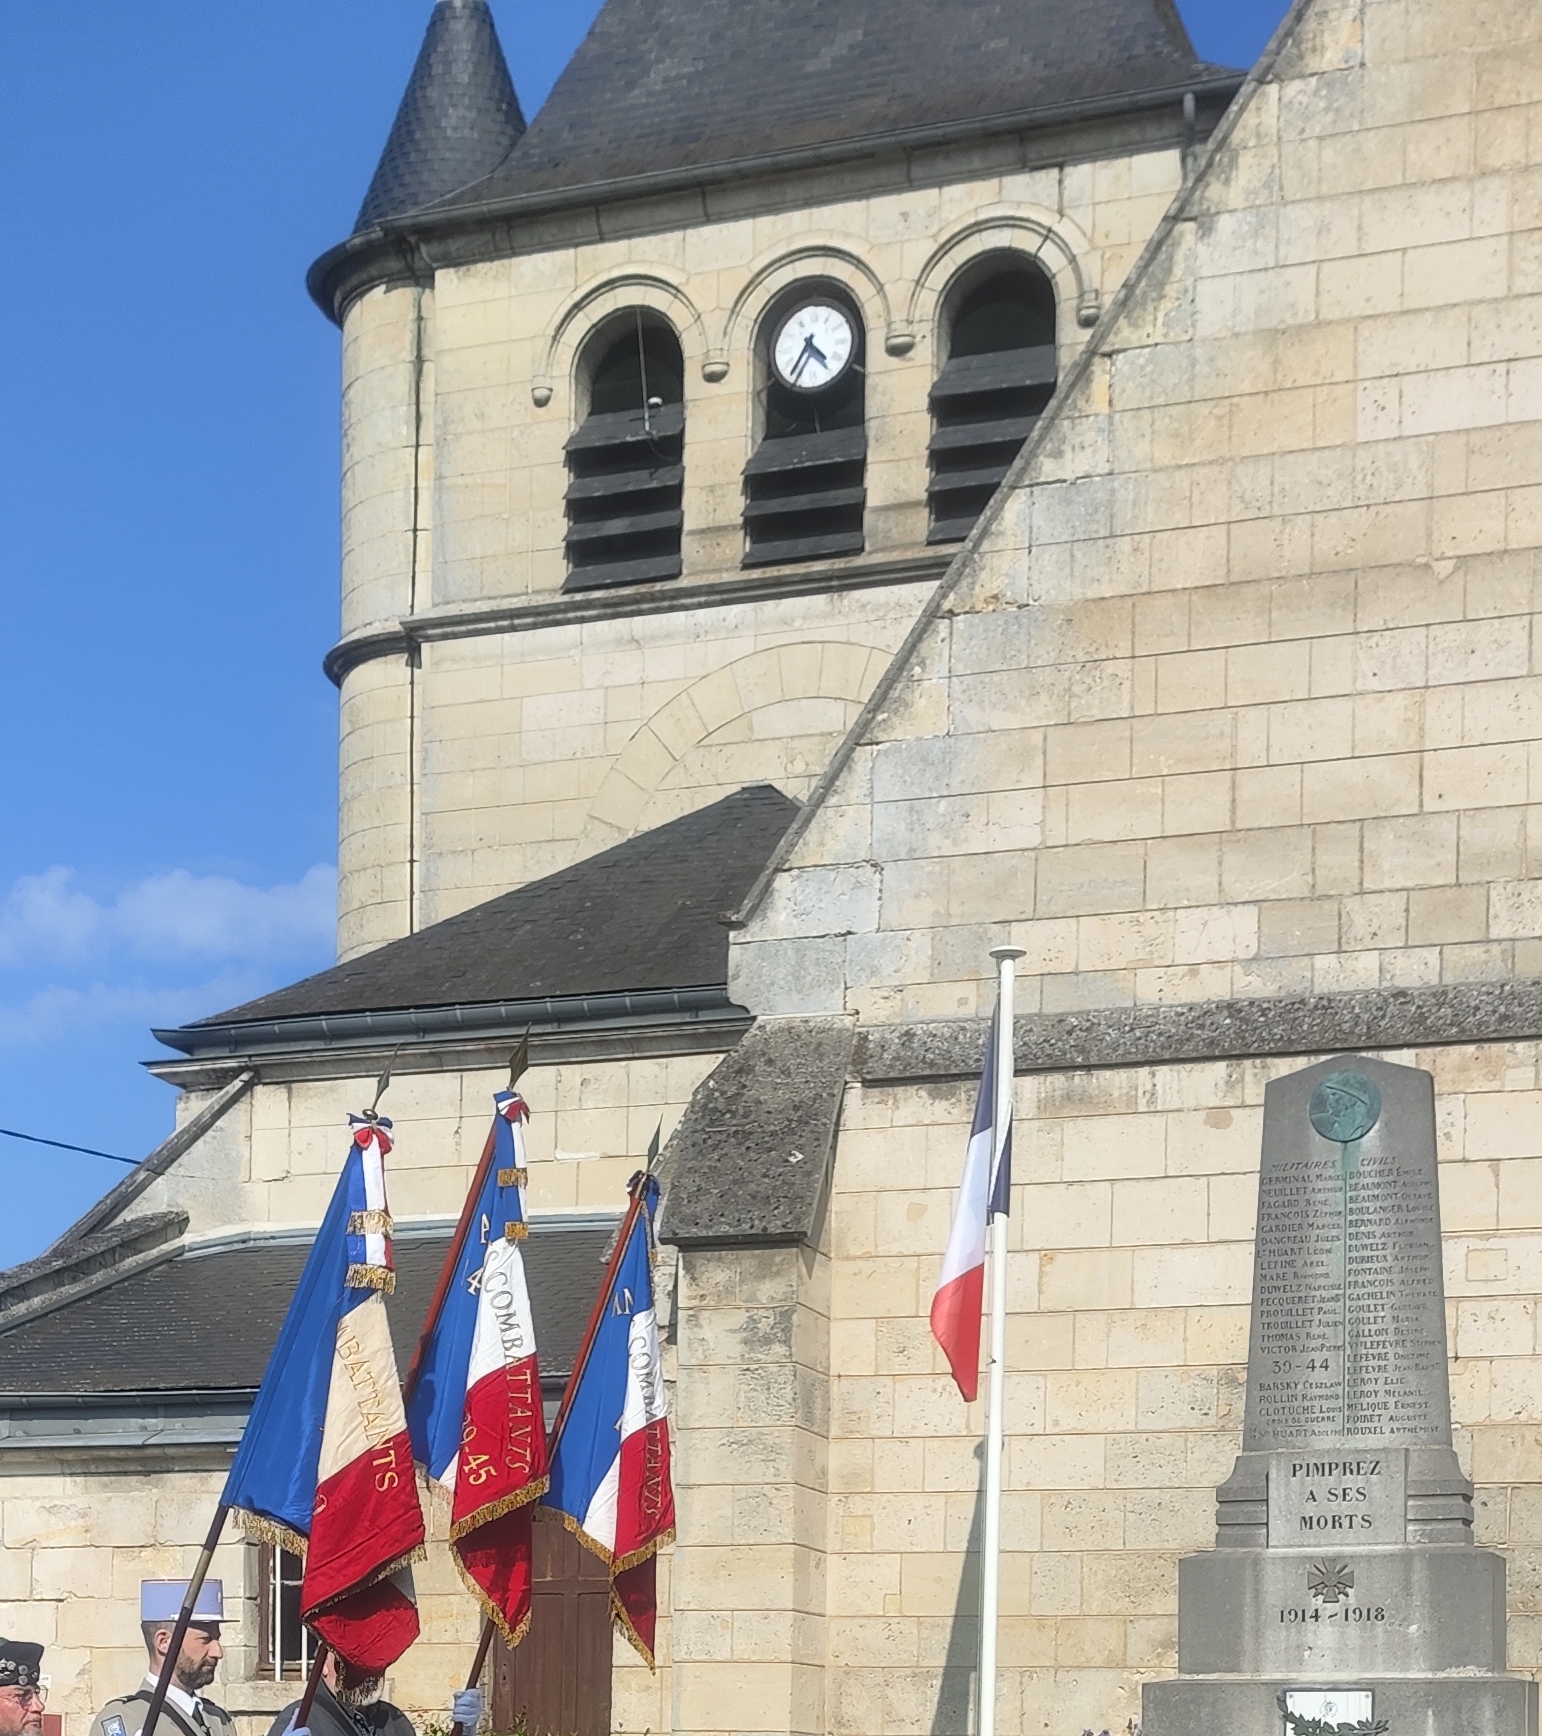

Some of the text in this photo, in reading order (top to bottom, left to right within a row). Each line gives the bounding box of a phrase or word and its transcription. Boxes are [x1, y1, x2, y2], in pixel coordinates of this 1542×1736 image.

[1269, 1160, 1337, 1172] MILITAIRES
[1360, 1157, 1397, 1166] CIVILS
[1349, 1169, 1394, 1179] BOUCHER
[1262, 1175, 1313, 1186] GERMINAL
[1348, 1181, 1398, 1192] BEAUMONT
[1262, 1187, 1308, 1197] NEUILLET
[1348, 1193, 1398, 1204] BEAUMONT
[1261, 1199, 1299, 1210] FAGARD
[1348, 1205, 1403, 1216] BOULANGER
[1348, 1218, 1391, 1228] BERNARD
[1348, 1231, 1376, 1241] DENIS
[1348, 1243, 1387, 1253] DUWELZ
[1348, 1255, 1388, 1265] DURIEUX
[1348, 1266, 1393, 1277] FONTAINE
[1260, 1284, 1302, 1294] DUWELZ
[1261, 1296, 1317, 1306] PECQUERET
[1348, 1291, 1396, 1301] GACHELIN
[1260, 1308, 1315, 1318] PROUILLET
[1348, 1303, 1386, 1313] GOULET
[1261, 1320, 1315, 1330] TROUILLET
[1348, 1315, 1386, 1326] GOULET
[1261, 1332, 1300, 1342] THOMAS
[1348, 1328, 1388, 1338] GALLON
[1260, 1345, 1297, 1354] VICTOR
[483, 1271, 533, 1473] COMBATTANTS
[1259, 1381, 1299, 1391] BARSKY
[1347, 1377, 1379, 1387] LEROY
[1259, 1394, 1297, 1404] ROLLIN
[1347, 1390, 1379, 1399] LEROY
[1259, 1405, 1316, 1416] CLOTUCHE
[1347, 1426, 1385, 1436] ROUXEL
[1292, 1461, 1381, 1477] PIMPREZ
[1305, 1487, 1367, 1503] A SES
[1300, 1514, 1373, 1530] MORTS
